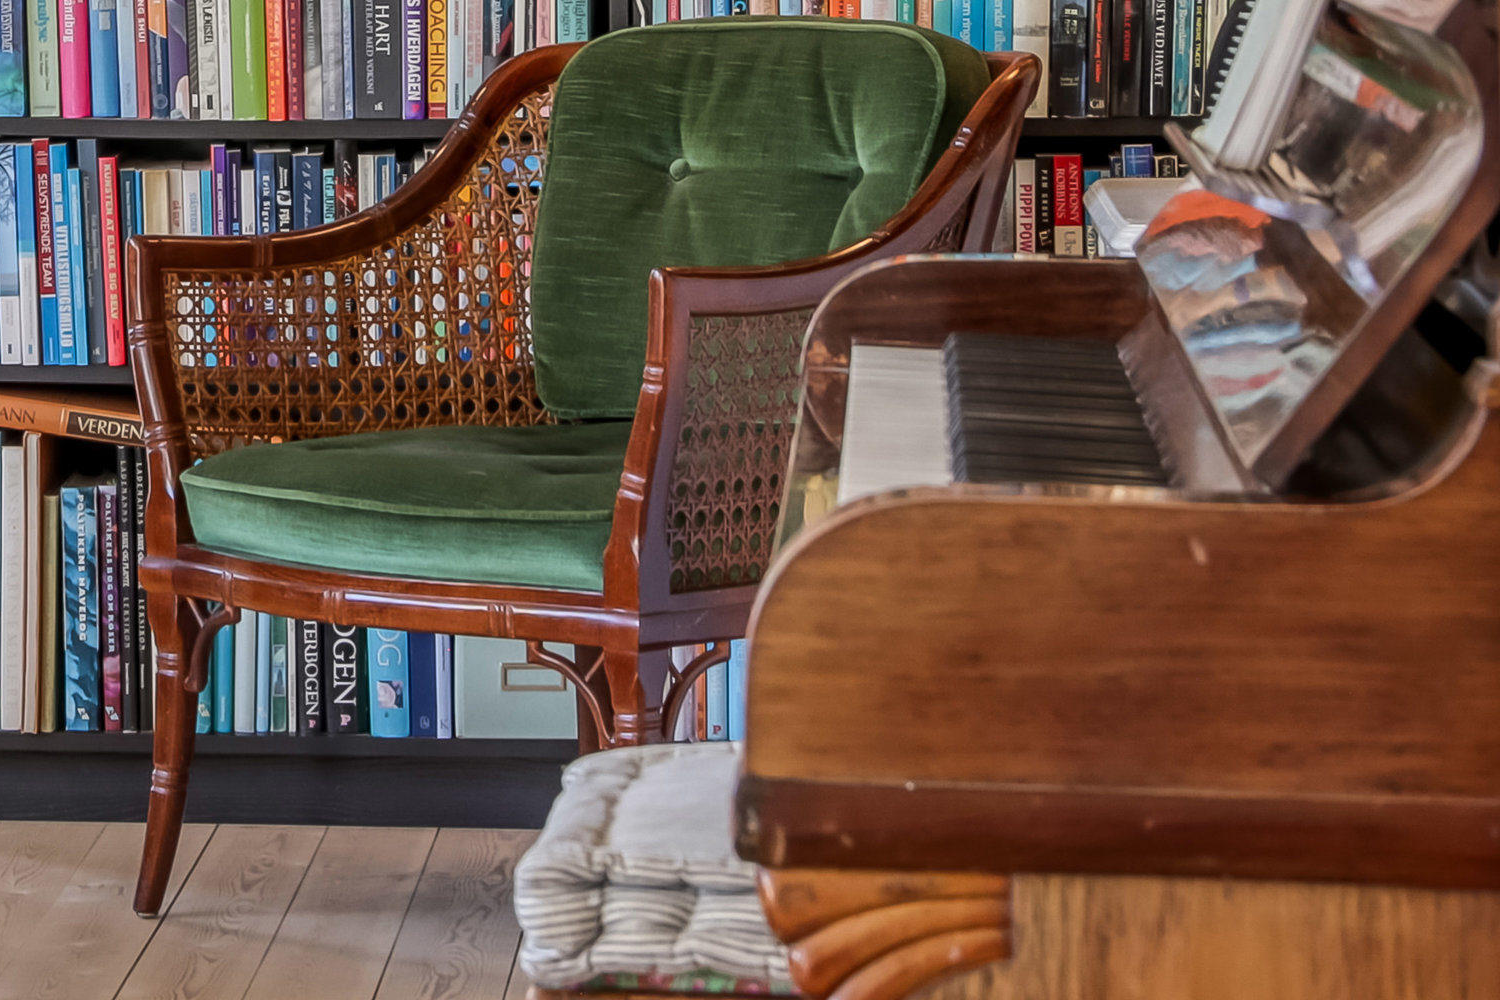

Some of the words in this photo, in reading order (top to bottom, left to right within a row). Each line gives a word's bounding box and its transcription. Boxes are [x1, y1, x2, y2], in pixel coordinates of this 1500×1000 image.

[137, 17, 146, 43] SHUI
[202, 6, 214, 45] LÆNGSEL
[375, 5, 390, 55] HART
[366, 36, 374, 56] MED
[407, 18, 421, 100] HVERDAGEN
[366, 59, 374, 94] VOKSNE
[104, 164, 115, 215] KUNSTEN
[1055, 168, 1067, 219] ROBBINS
[1068, 162, 1079, 222] ANTHONY
[37, 173, 51, 253] SELVSTYRENDE
[106, 218, 115, 231] AT
[107, 235, 116, 269] ELSKE
[41, 256, 52, 287] TEAM
[108, 272, 117, 290] SIG
[109, 294, 119, 319] SELV
[76, 494, 86, 572] POLITIKENS
[105, 493, 113, 564] POLITIKENS
[78, 577, 87, 641] HAVEBOG
[107, 594, 114, 613] OM
[107, 615, 116, 653] ROSER
